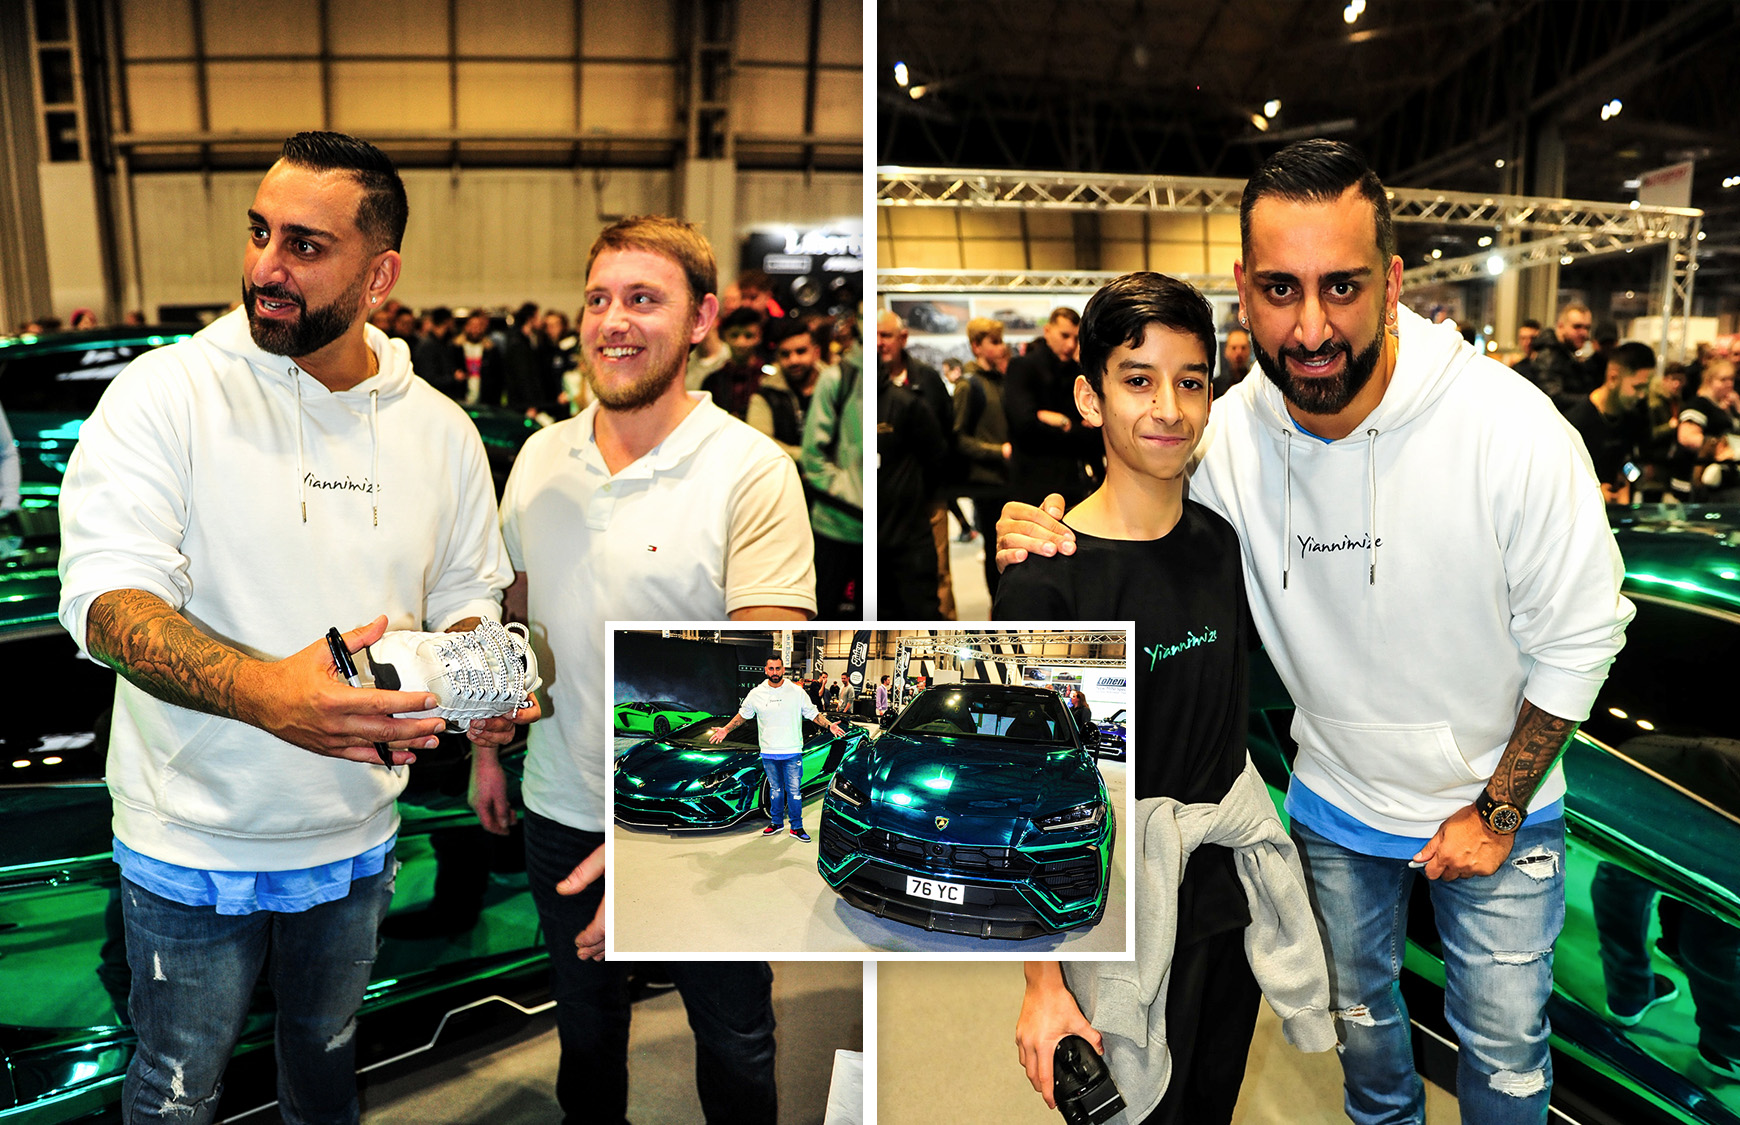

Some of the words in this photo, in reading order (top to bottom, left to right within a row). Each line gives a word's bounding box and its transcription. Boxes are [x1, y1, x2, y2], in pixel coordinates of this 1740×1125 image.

[1143, 625, 1218, 672] Yiannimize
[912, 879, 932, 896] 76
[938, 884, 959, 901] YC
